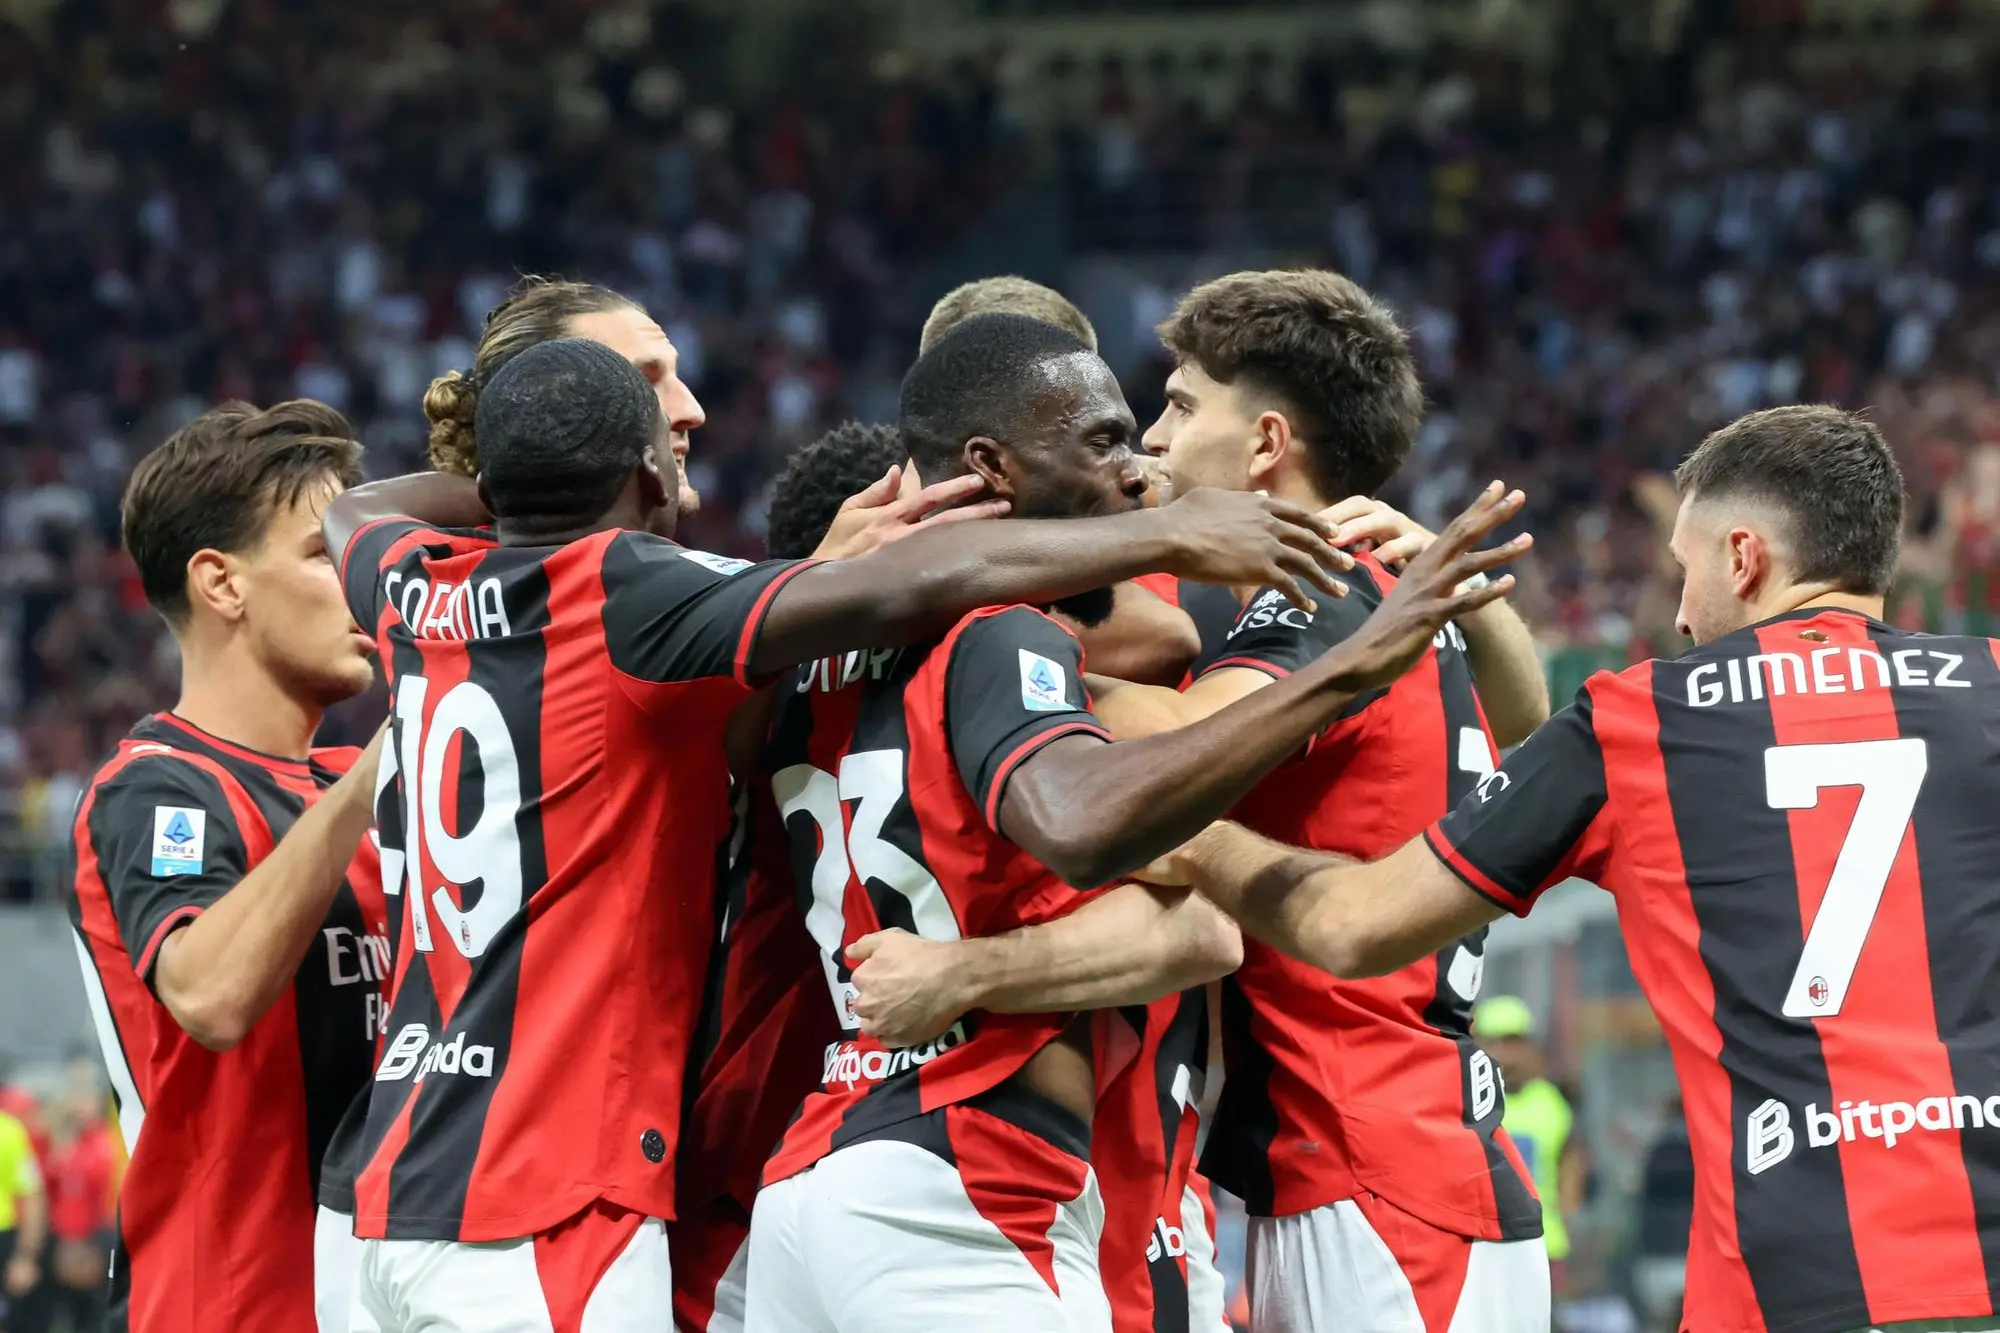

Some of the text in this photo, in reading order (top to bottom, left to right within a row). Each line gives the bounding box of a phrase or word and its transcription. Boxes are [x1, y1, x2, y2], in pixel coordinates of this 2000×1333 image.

[396, 674, 523, 959] 19
[771, 748, 962, 1030] 23
[1764, 738, 1928, 1017] 7
